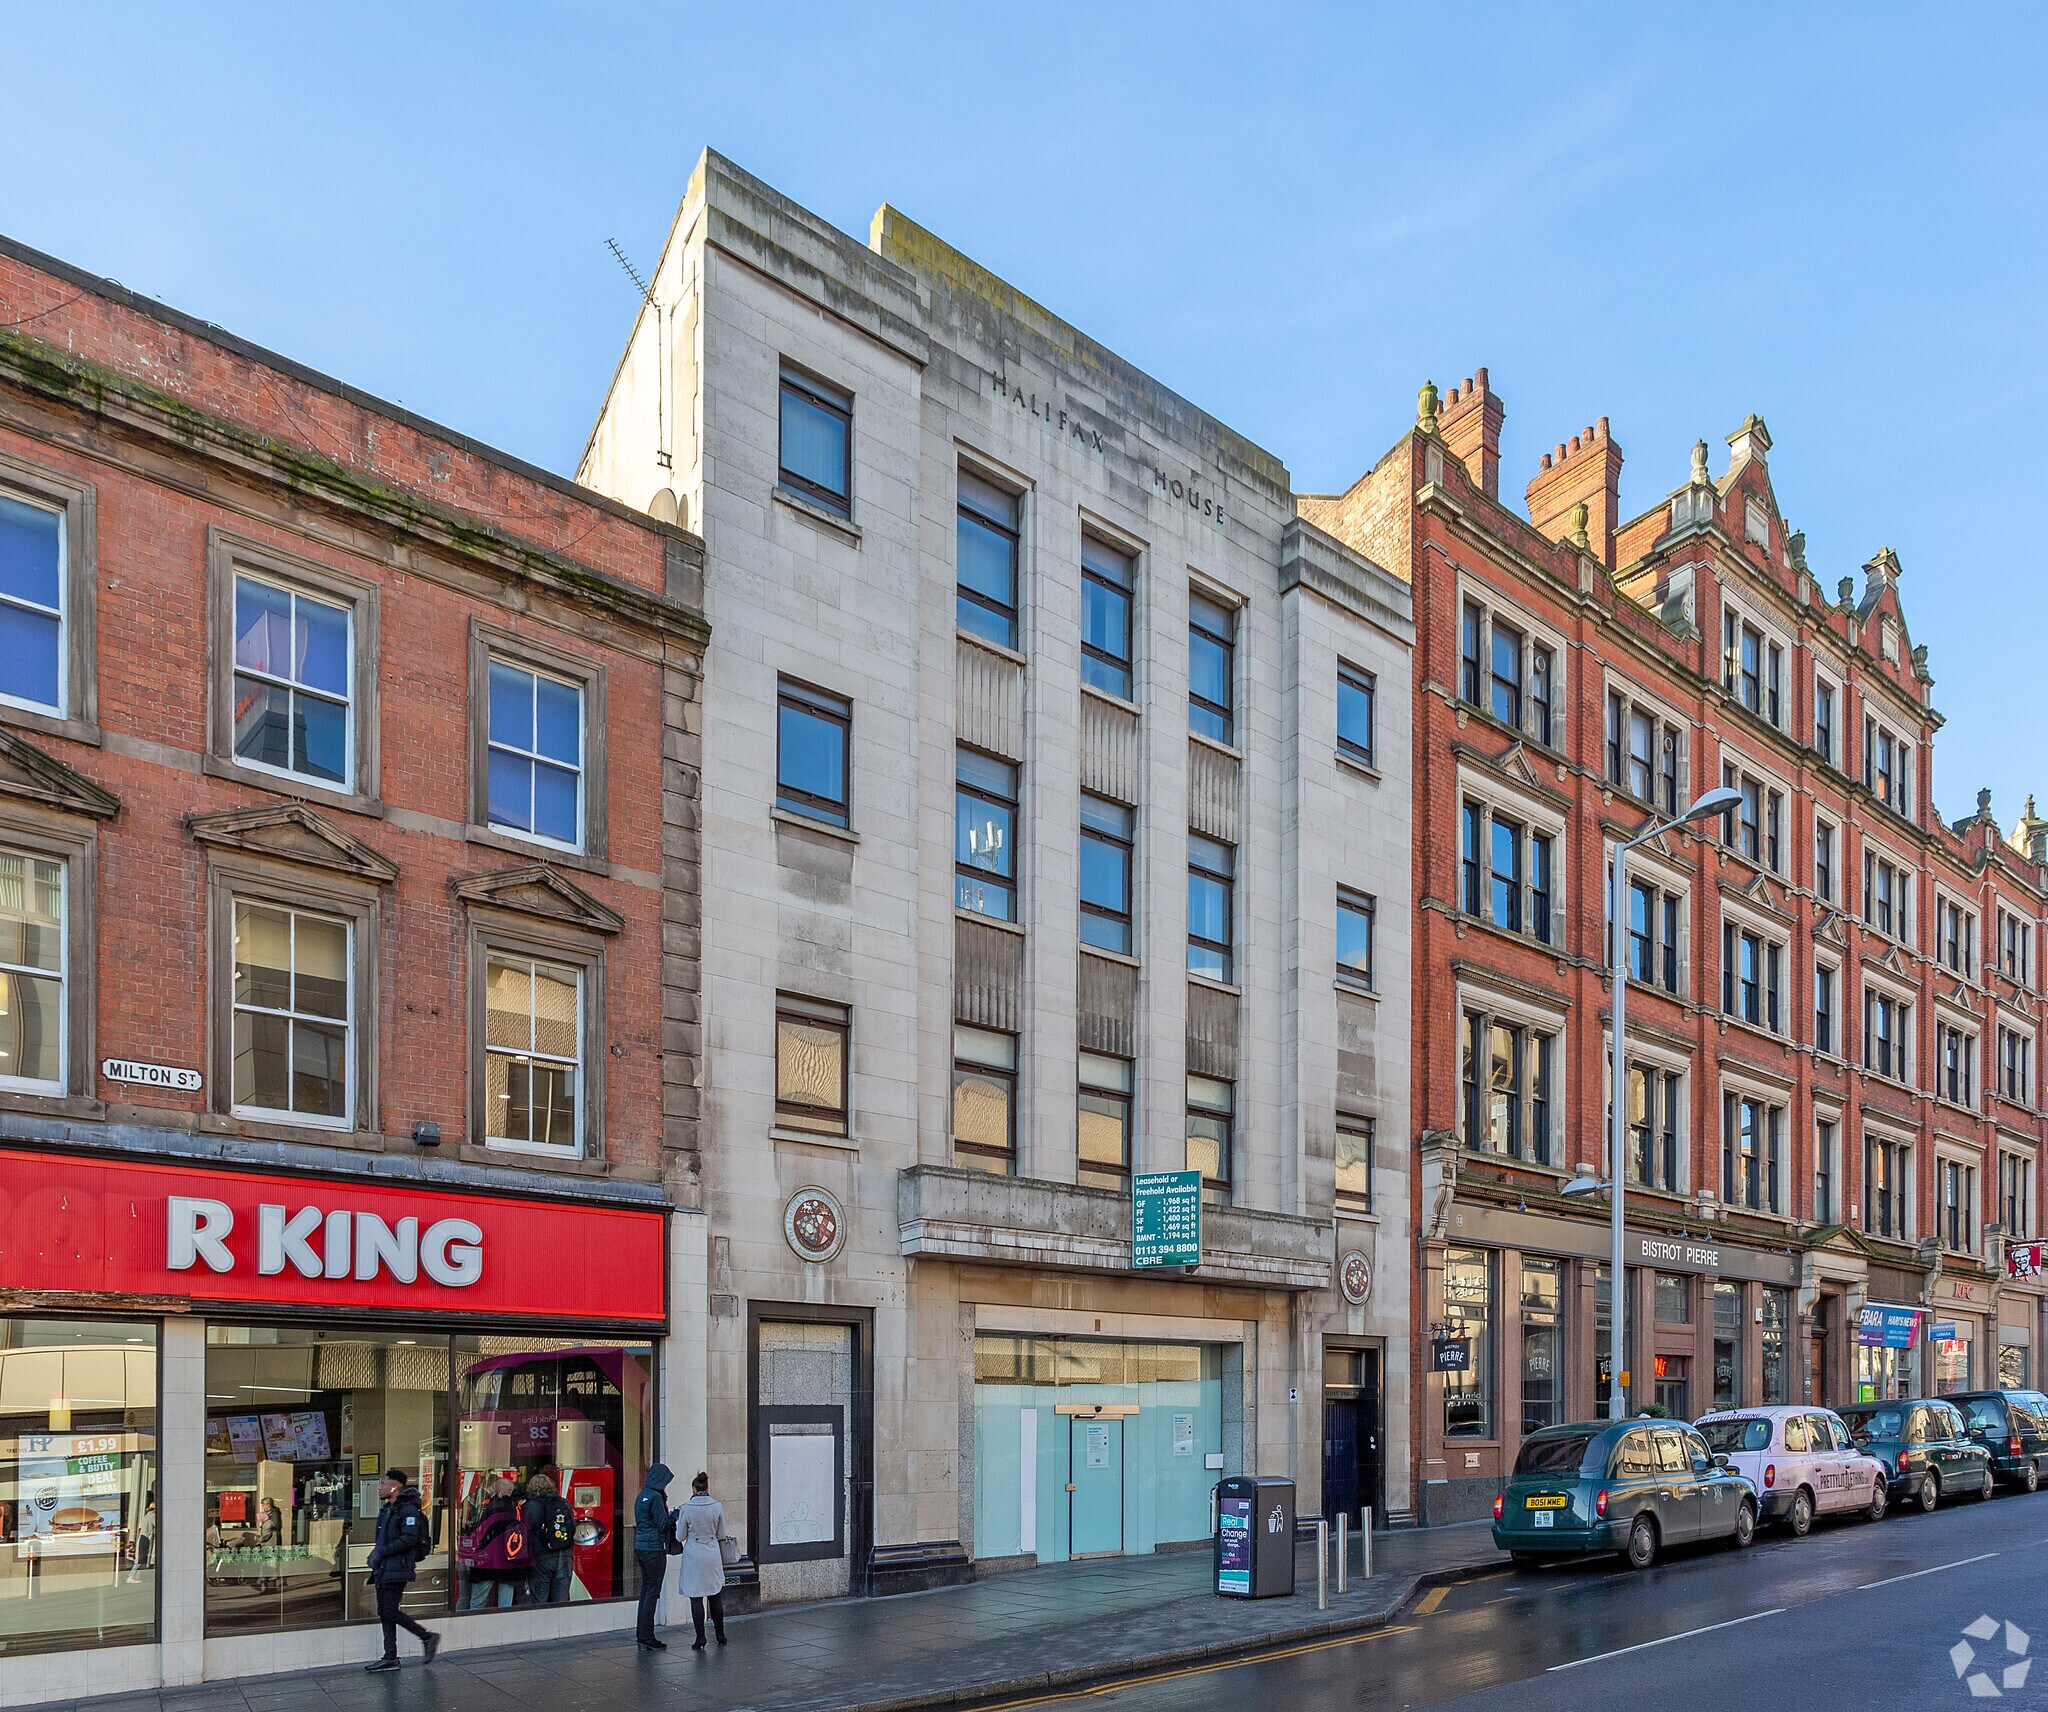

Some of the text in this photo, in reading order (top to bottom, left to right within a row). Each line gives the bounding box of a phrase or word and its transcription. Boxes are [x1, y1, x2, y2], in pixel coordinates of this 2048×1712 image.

[993, 371, 1224, 524] HALIFAX HOUSE
[109, 1062, 171, 1083] MILTON
[1136, 1175, 1169, 1185] Leasehold
[1136, 1184, 1197, 1196] Freehold Available
[1163, 1197, 1180, 1206] 1,968
[1163, 1206, 1180, 1214] 1,422
[1191, 1204, 1196, 1212] ft
[1163, 1214, 1180, 1222] 1,400
[1163, 1223, 1180, 1231] 1,469
[167, 1195, 484, 1287] R KING
[1136, 1234, 1156, 1242] BMNT
[1163, 1232, 1180, 1240] 1,194
[1135, 1243, 1197, 1255] 0113 394 8800
[1641, 1240, 1719, 1267] BISTROT PIERRE
[1136, 1256, 1163, 1265] CBRE
[1955, 1281, 1974, 1300] KFC
[1440, 1351, 1464, 1363] PIERRE
[1529, 1356, 1550, 1372] PIERRE
[1717, 1365, 1733, 1379] PIERRE
[78, 1437, 116, 1453] £1.99
[78, 1455, 107, 1465] COFFEE
[79, 1462, 115, 1473] & BUTTY
[88, 1471, 116, 1485] DEAL
[1222, 1517, 1238, 1526] Real
[1222, 1529, 1247, 1540] Change
